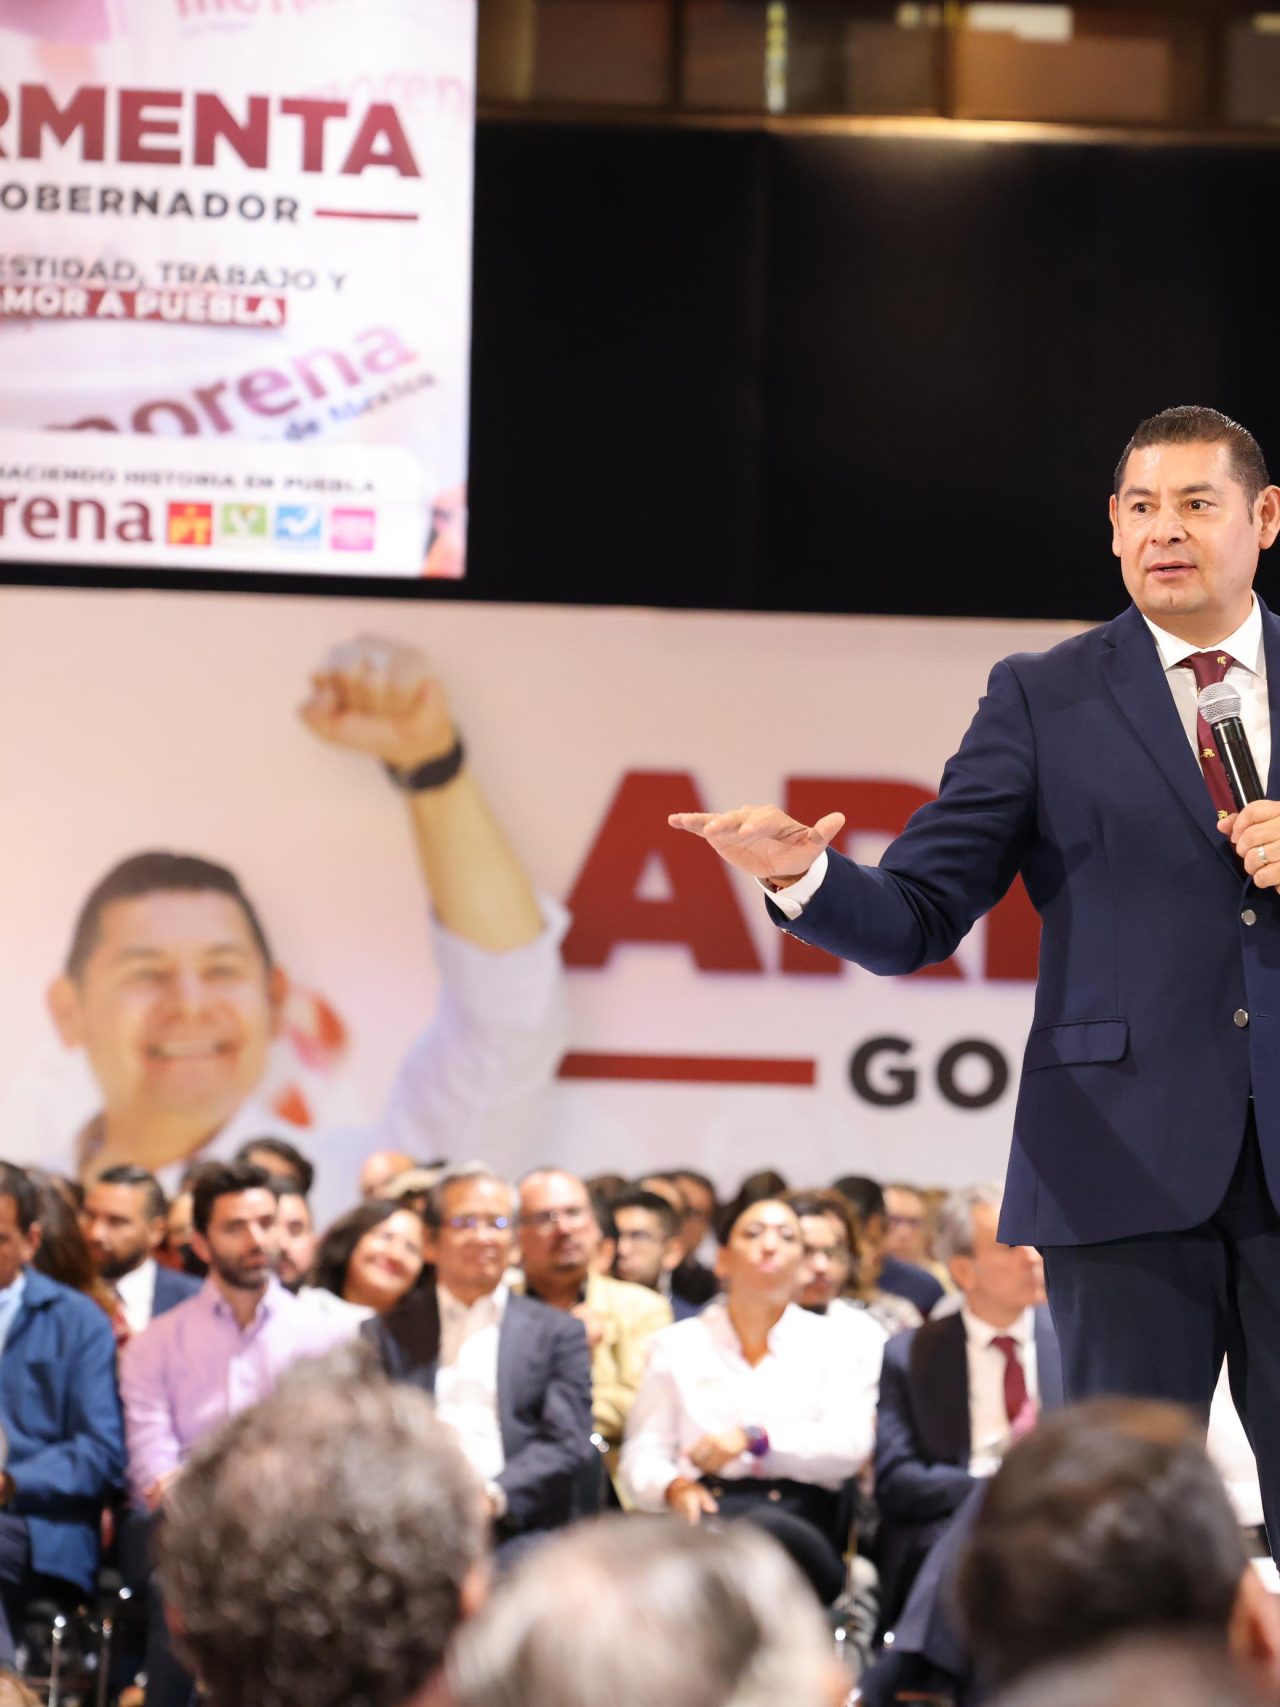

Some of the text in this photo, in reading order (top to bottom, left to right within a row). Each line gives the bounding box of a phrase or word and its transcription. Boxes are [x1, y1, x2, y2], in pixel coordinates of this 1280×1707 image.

[0, 82, 421, 178] MENTA
[0, 181, 299, 222] OBERNADOR
[158, 261, 317, 290] TRABAJO
[329, 272, 347, 292] Y
[97, 289, 126, 318] A
[134, 291, 282, 324] PUEBLA
[40, 326, 416, 436] orena
